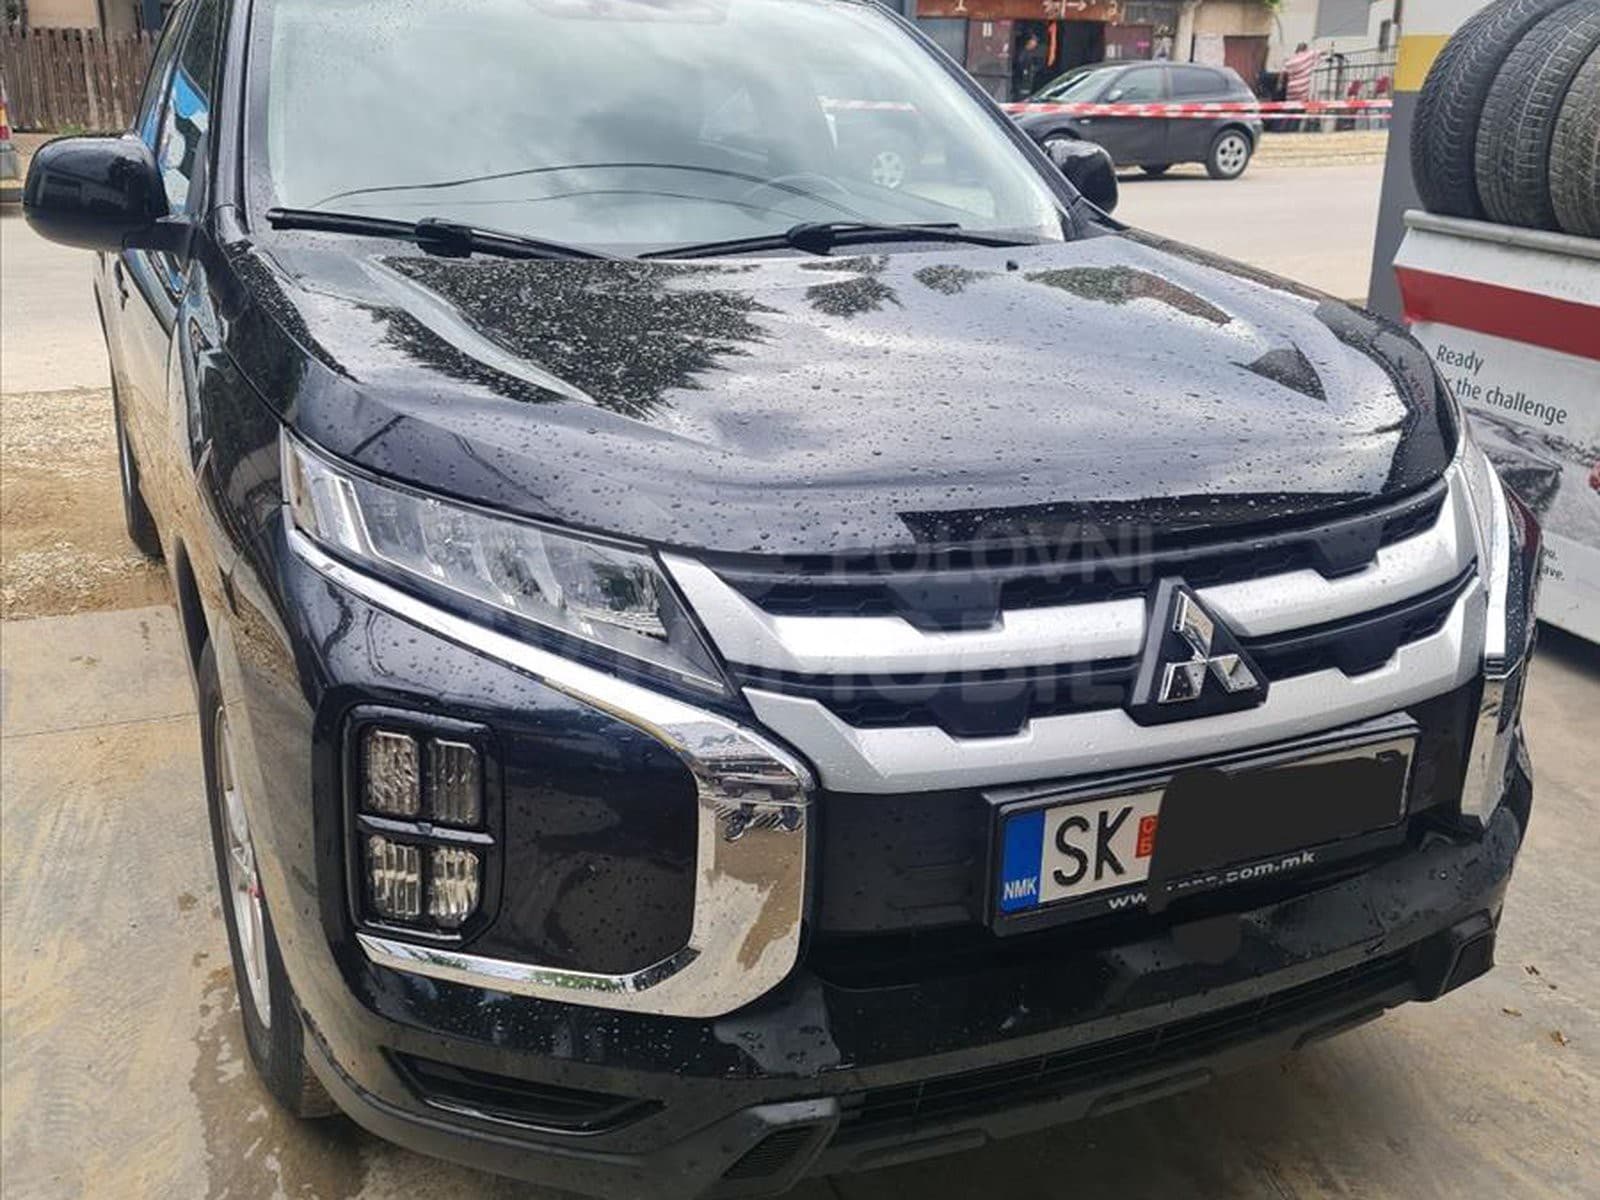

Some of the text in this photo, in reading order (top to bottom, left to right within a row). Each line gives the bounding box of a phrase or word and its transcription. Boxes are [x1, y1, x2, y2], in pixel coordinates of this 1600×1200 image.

[1437, 344, 1484, 374] Ready
[1456, 377, 1567, 426] the challenge
[1053, 806, 1133, 886] SK
[1003, 878, 1038, 900] NMK
